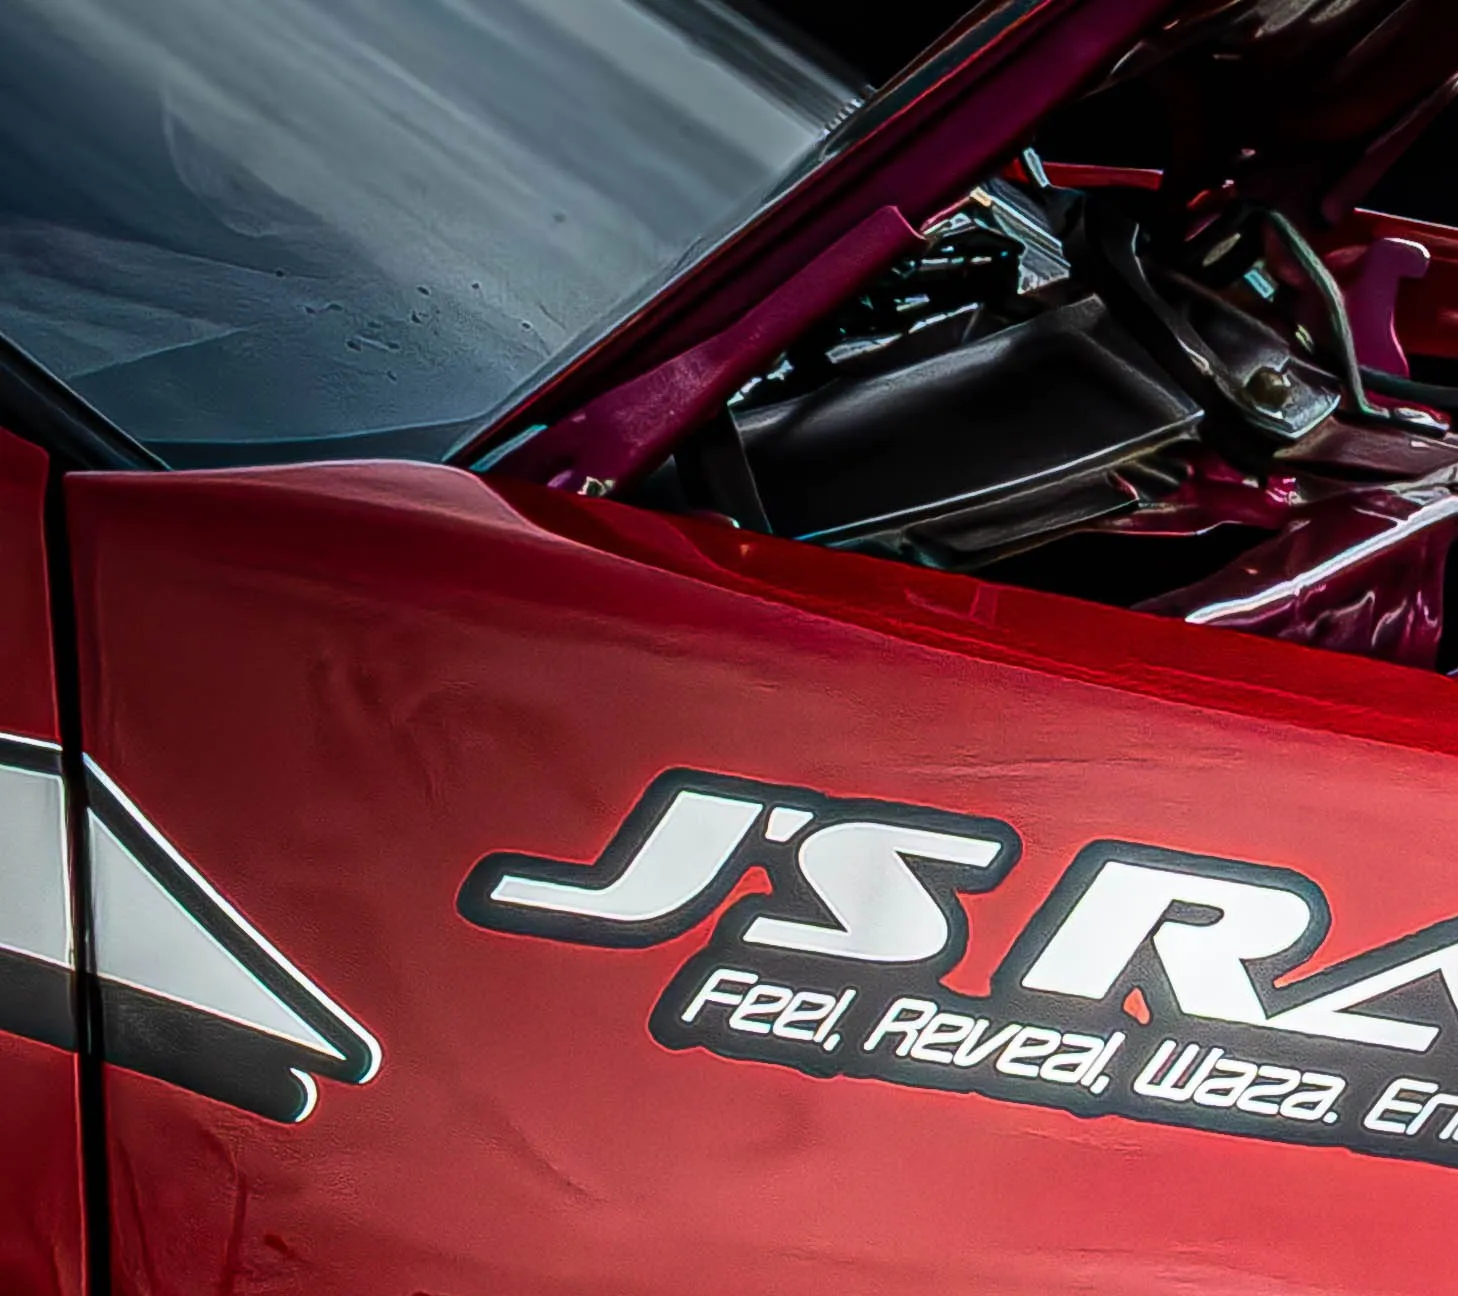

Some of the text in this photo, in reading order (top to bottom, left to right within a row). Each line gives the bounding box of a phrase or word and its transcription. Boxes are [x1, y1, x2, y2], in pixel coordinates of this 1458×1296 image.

[489, 791, 1000, 964] J'S
[681, 968, 858, 1053] Feel,
[863, 996, 1125, 1095] Reveal,
[1133, 1039, 1348, 1125] Waza.
